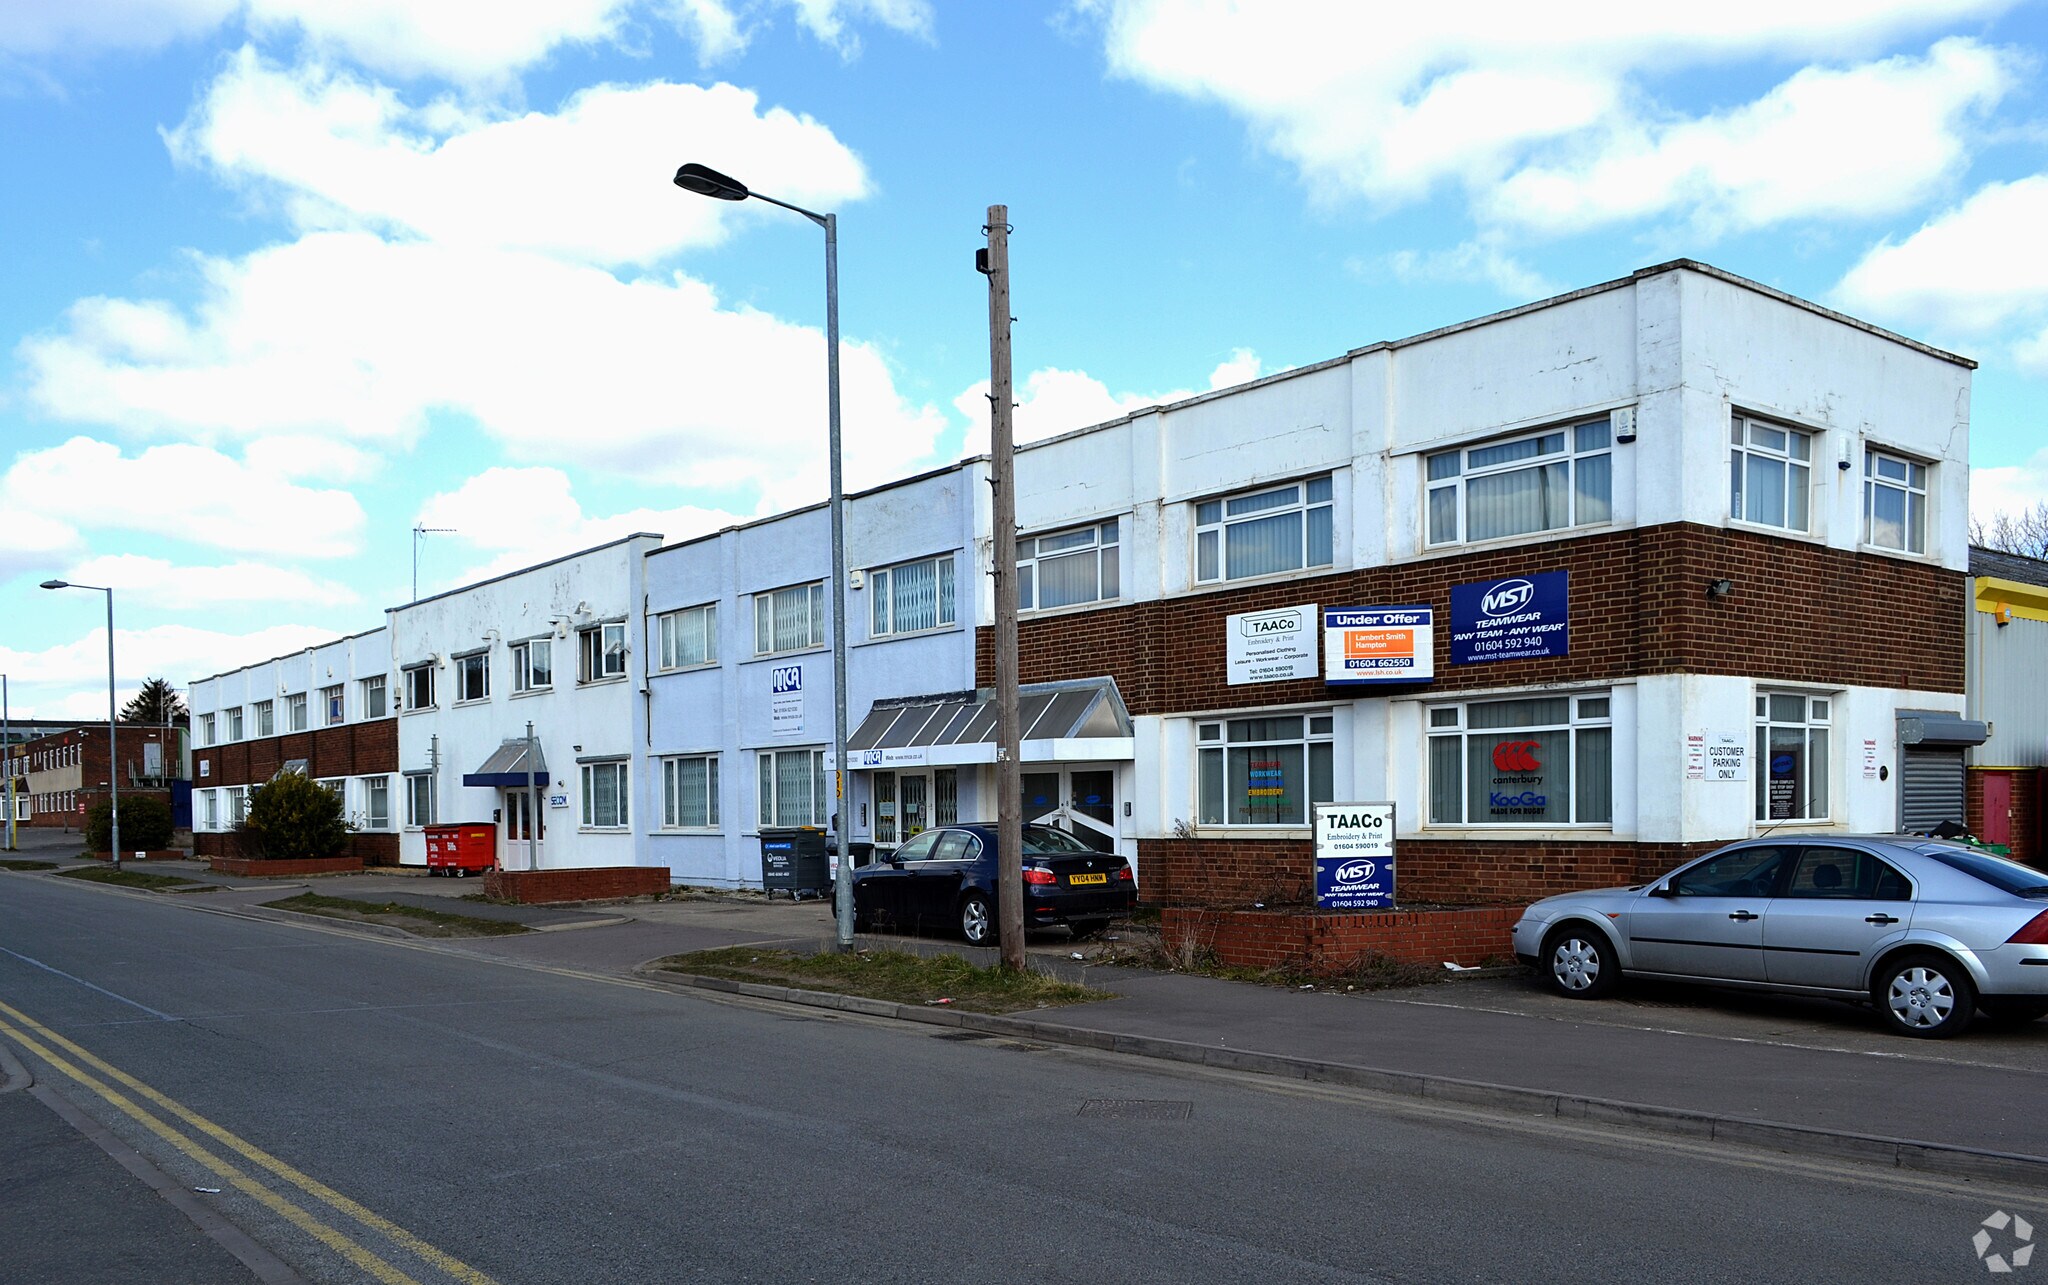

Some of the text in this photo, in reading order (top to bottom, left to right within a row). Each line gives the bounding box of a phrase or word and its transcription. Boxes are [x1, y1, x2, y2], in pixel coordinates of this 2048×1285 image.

[1482, 584, 1534, 612] MST
[1336, 614, 1420, 625] Under Offer
[1476, 612, 1541, 629] TEAMWEAR
[1253, 620, 1294, 632] TAACo
[1476, 630, 1503, 639] TEAM
[1509, 626, 1531, 635] ANY
[1248, 638, 1274, 646] Embroidery
[1475, 636, 1542, 652] 01604 592 940
[1468, 647, 1550, 661] www.mst-teamwear.co.uk
[1378, 658, 1410, 667] 662550
[1249, 672, 1294, 680] www.taaco.co.uk
[1710, 747, 1744, 756] CUSTOMER
[1713, 758, 1741, 767] PARKING
[1492, 774, 1543, 785] canterbury
[1719, 770, 1735, 778] ONLY
[1490, 791, 1546, 806] KooGa
[1327, 814, 1382, 828] TAACo
[1327, 833, 1360, 841] Embroidery
[1336, 863, 1375, 880] MST
[1330, 883, 1380, 892] TEAMWEAR
